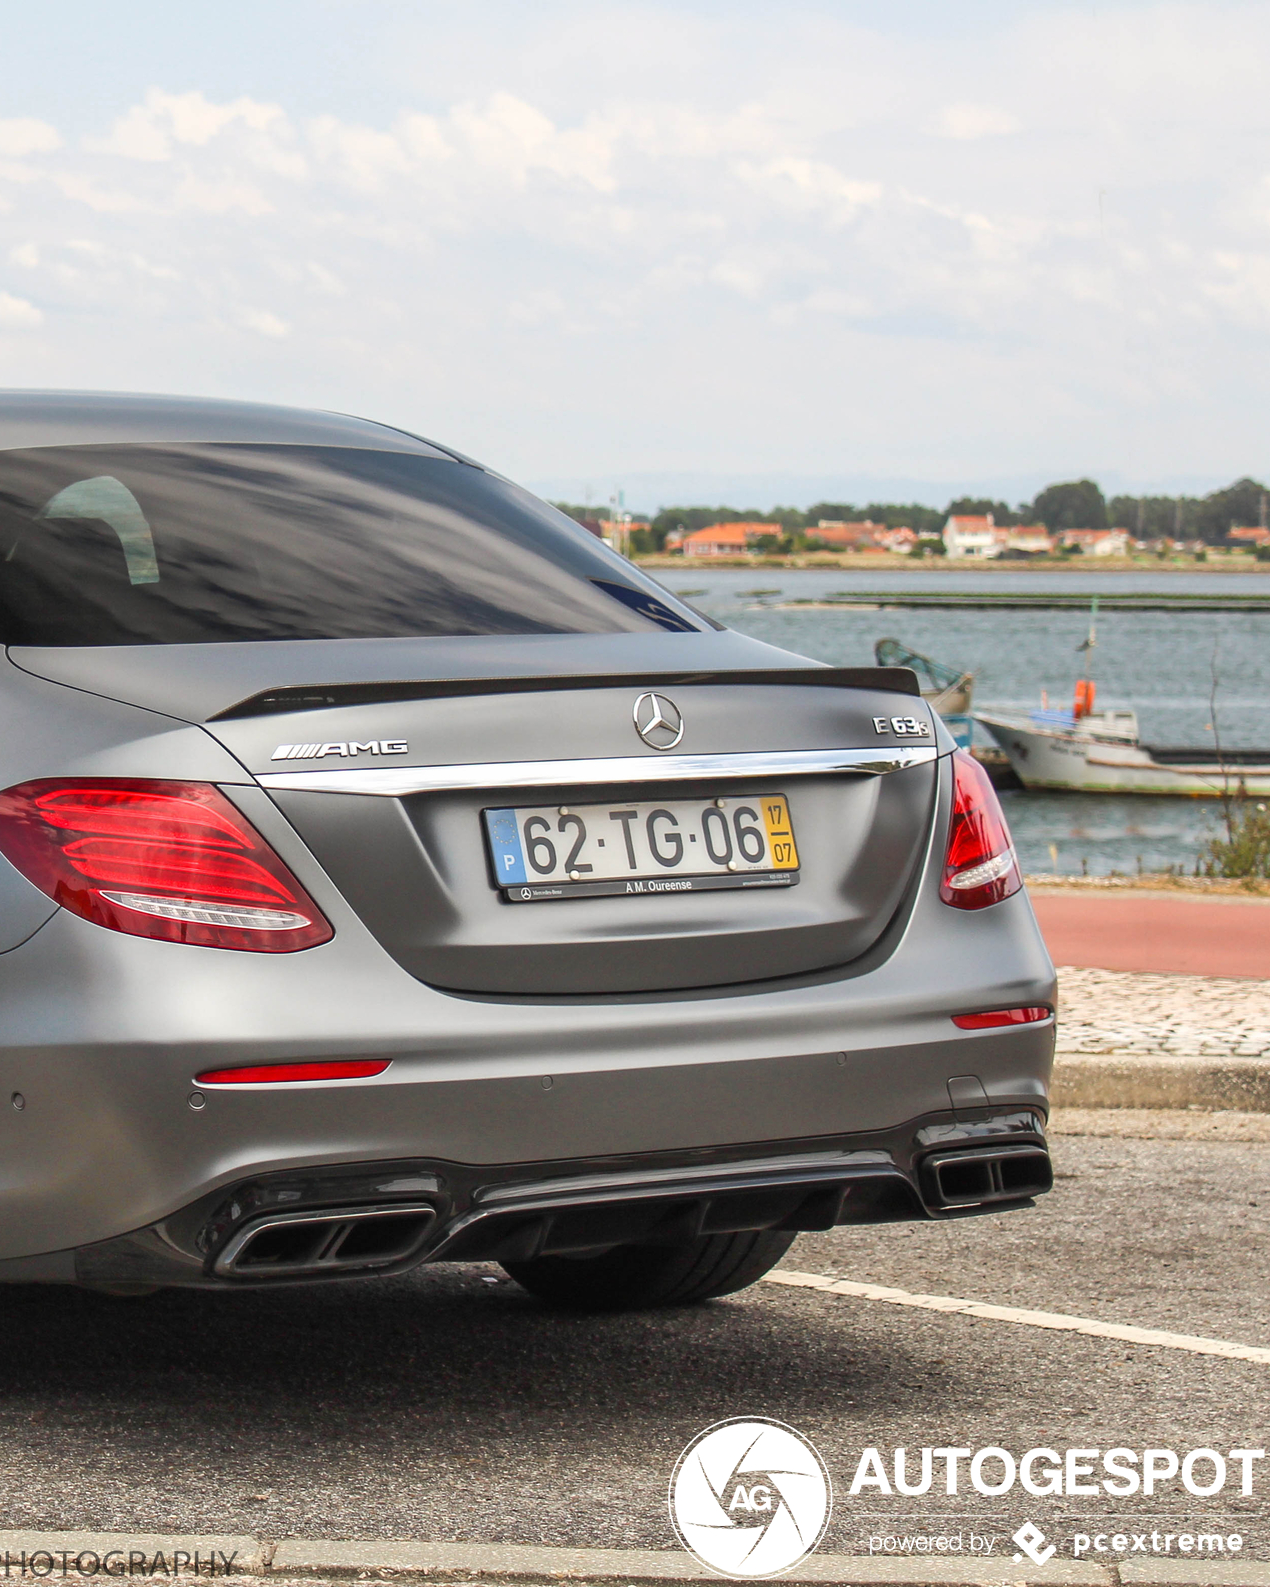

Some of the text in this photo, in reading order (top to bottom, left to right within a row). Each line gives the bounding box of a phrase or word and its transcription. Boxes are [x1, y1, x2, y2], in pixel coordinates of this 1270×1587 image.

[872, 717, 890, 734] E
[315, 740, 408, 758] AMG
[767, 805, 782, 825] 17
[773, 843, 792, 863] 07
[503, 855, 516, 871] P
[648, 880, 692, 891] Oureense
